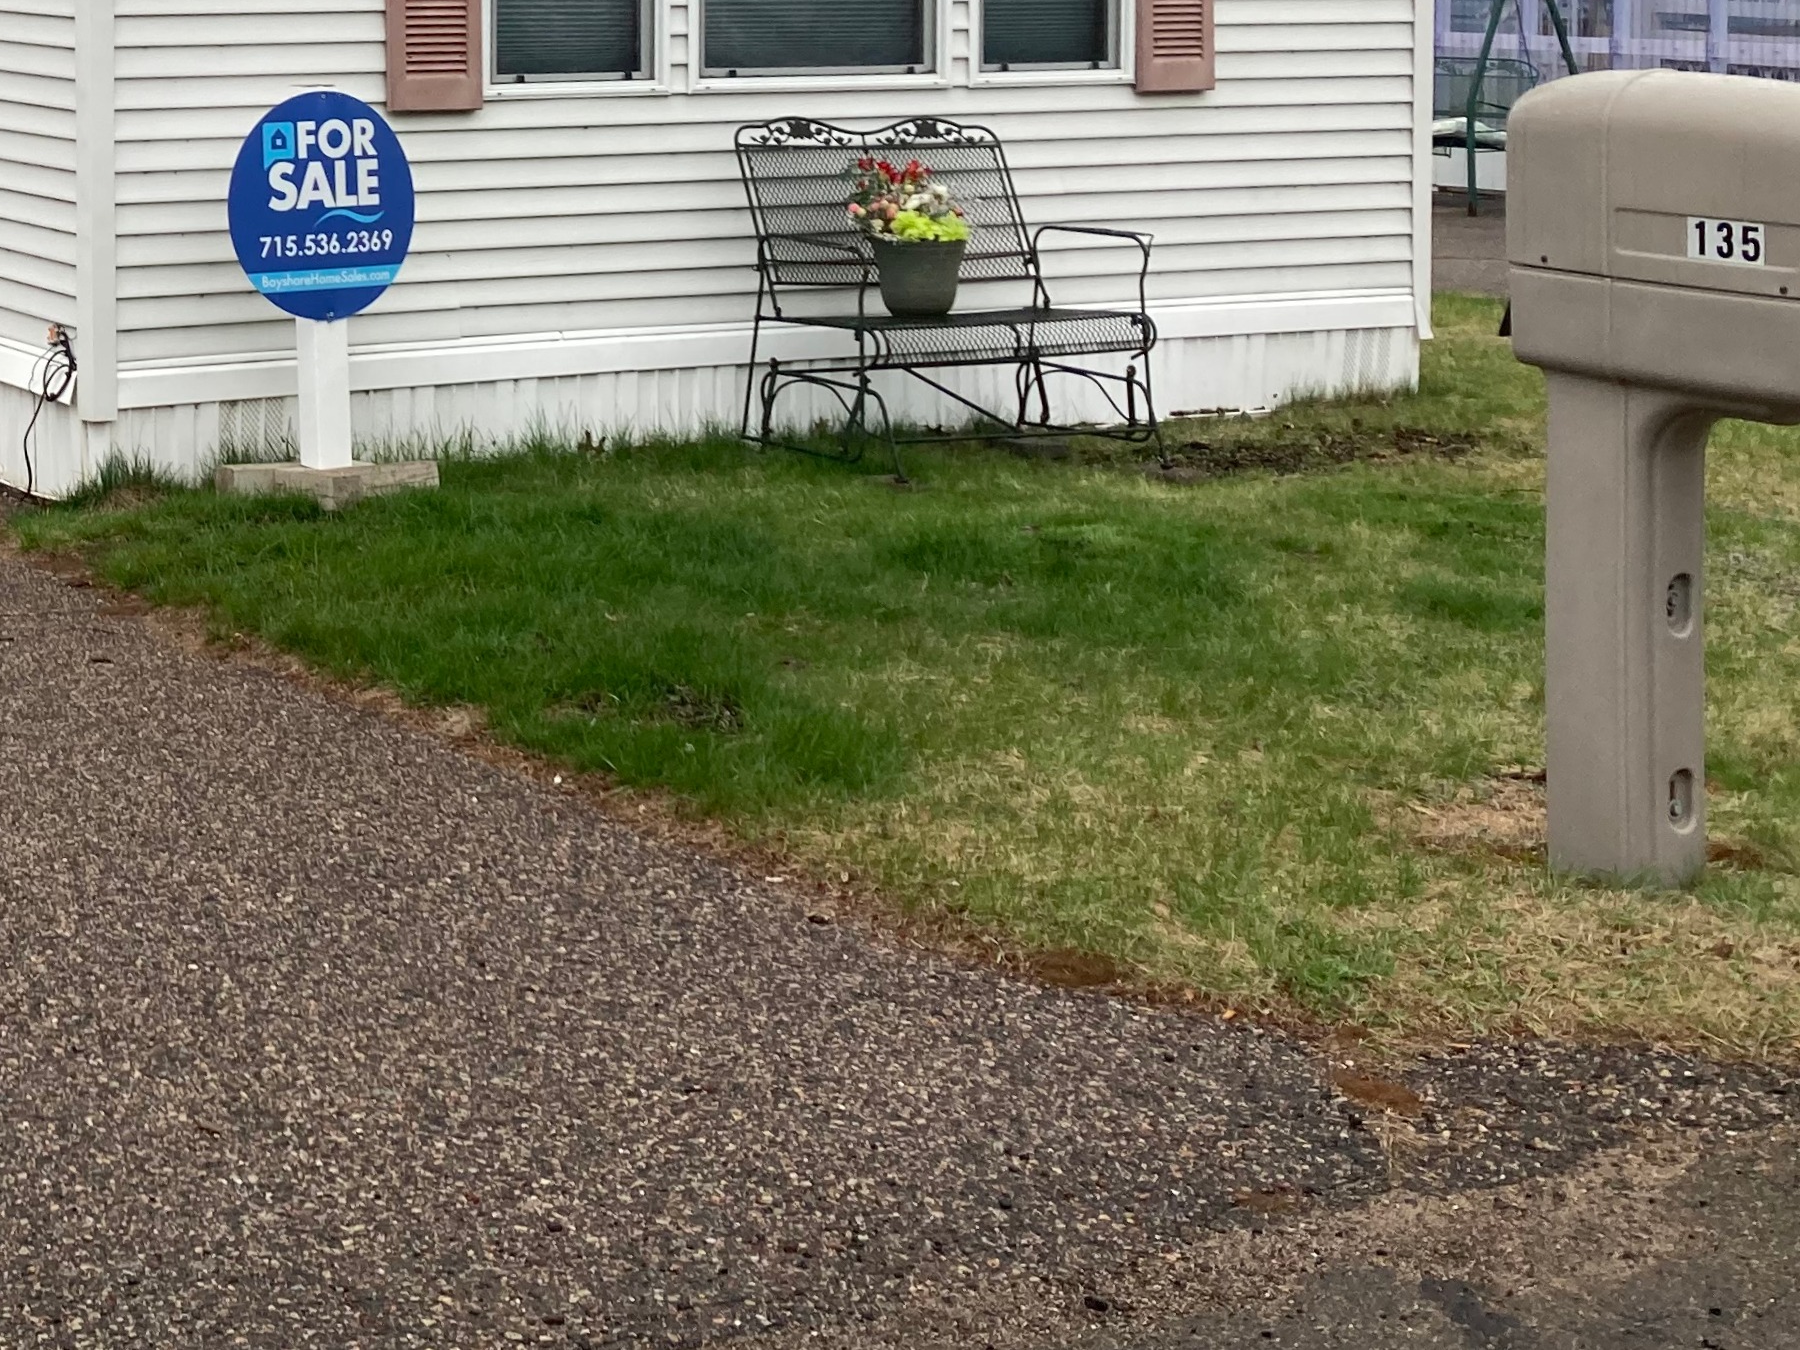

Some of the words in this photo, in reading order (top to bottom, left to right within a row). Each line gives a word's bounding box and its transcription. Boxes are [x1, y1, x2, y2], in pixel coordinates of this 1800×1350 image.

[296, 118, 378, 159] FOR
[267, 158, 380, 212] SALE
[259, 229, 393, 258] 715.536.2369
[1694, 220, 1761, 262] 135
